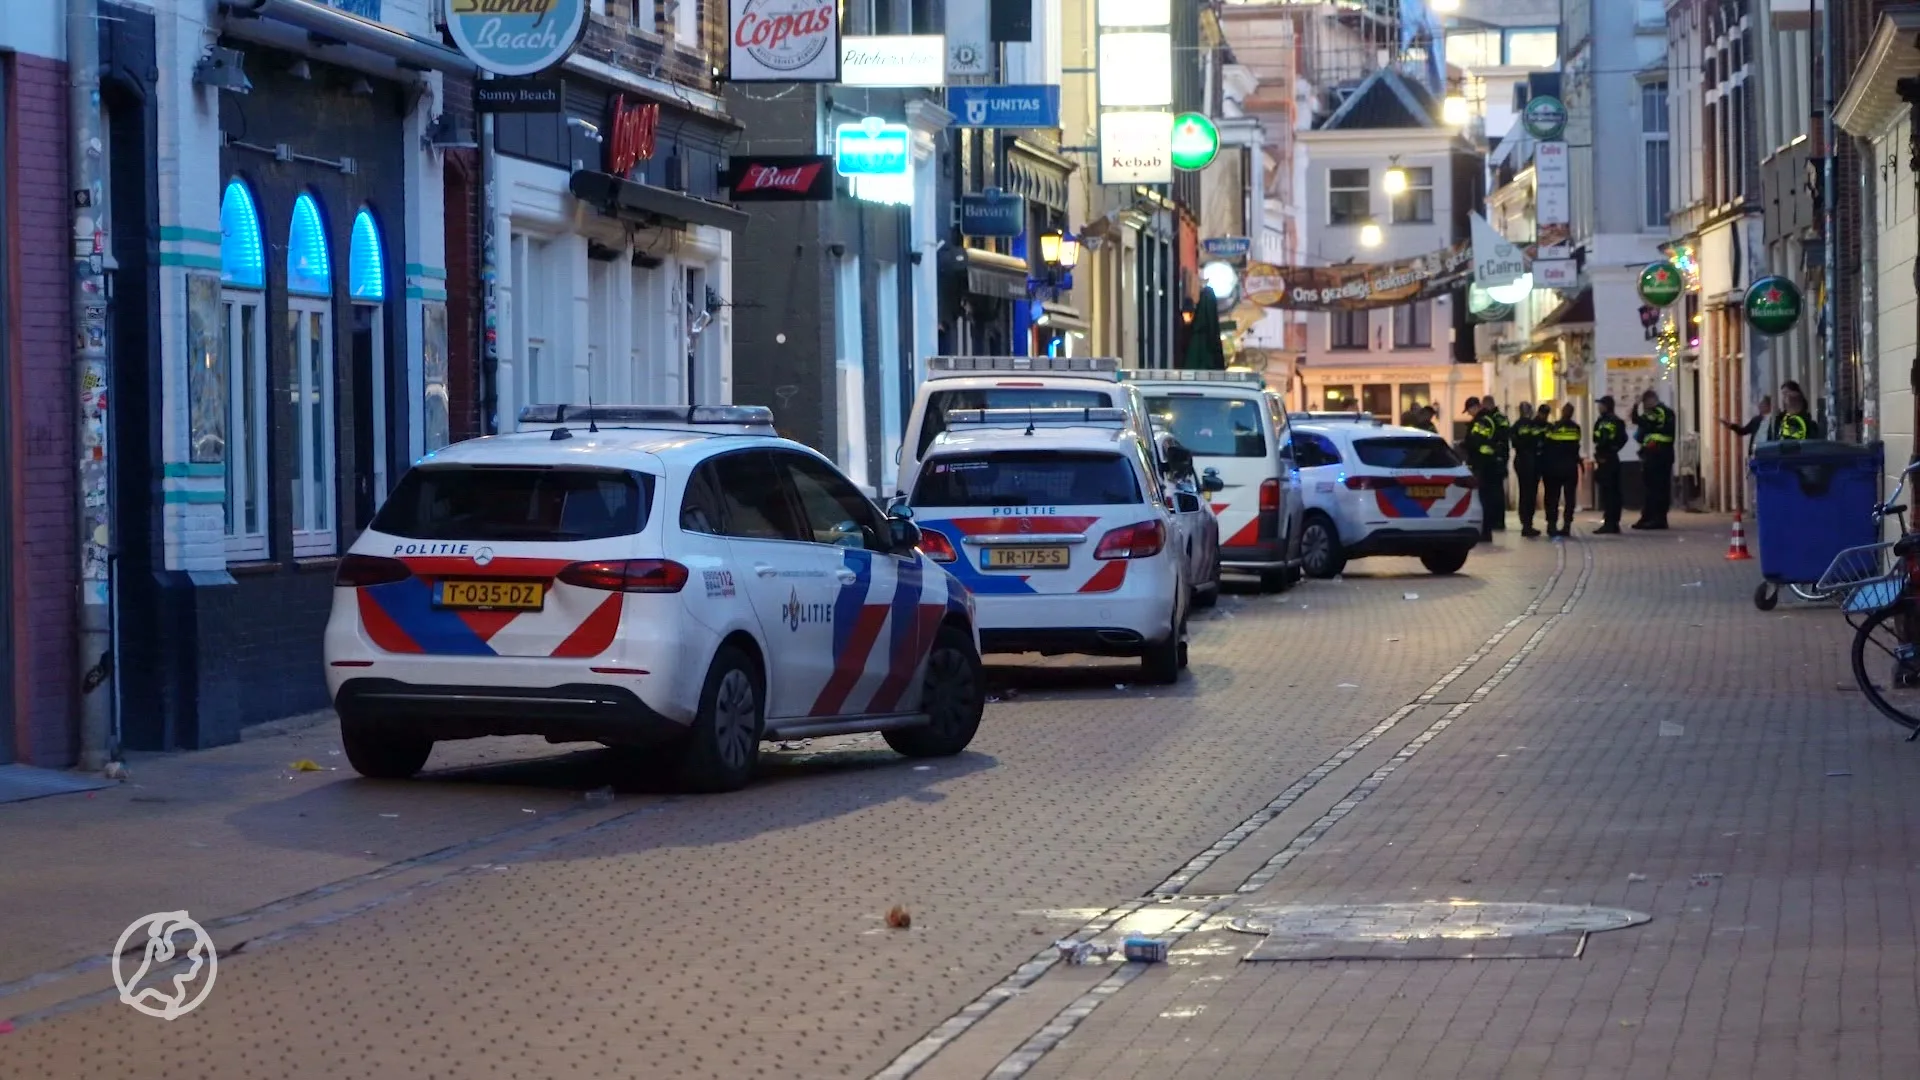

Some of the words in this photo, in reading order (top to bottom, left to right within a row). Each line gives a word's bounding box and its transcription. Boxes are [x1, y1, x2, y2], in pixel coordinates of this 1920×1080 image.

[474, 17, 557, 49] Beach
[734, 4, 833, 50] Copas
[479, 89, 518, 103] Sunny
[520, 89, 556, 101] Beach
[990, 98, 1040, 111] UNITAS
[1112, 156, 1162, 168] Kebab
[751, 166, 802, 188] Bud
[1292, 287, 1318, 302] Ons
[1751, 307, 1796, 317] Heineken
[992, 507, 1056, 515] POLITIE
[393, 544, 469, 555] POLITIE
[997, 550, 1061, 563] TR-175-S
[718, 570, 734, 586] 112
[448, 584, 535, 604] T-035-DZ
